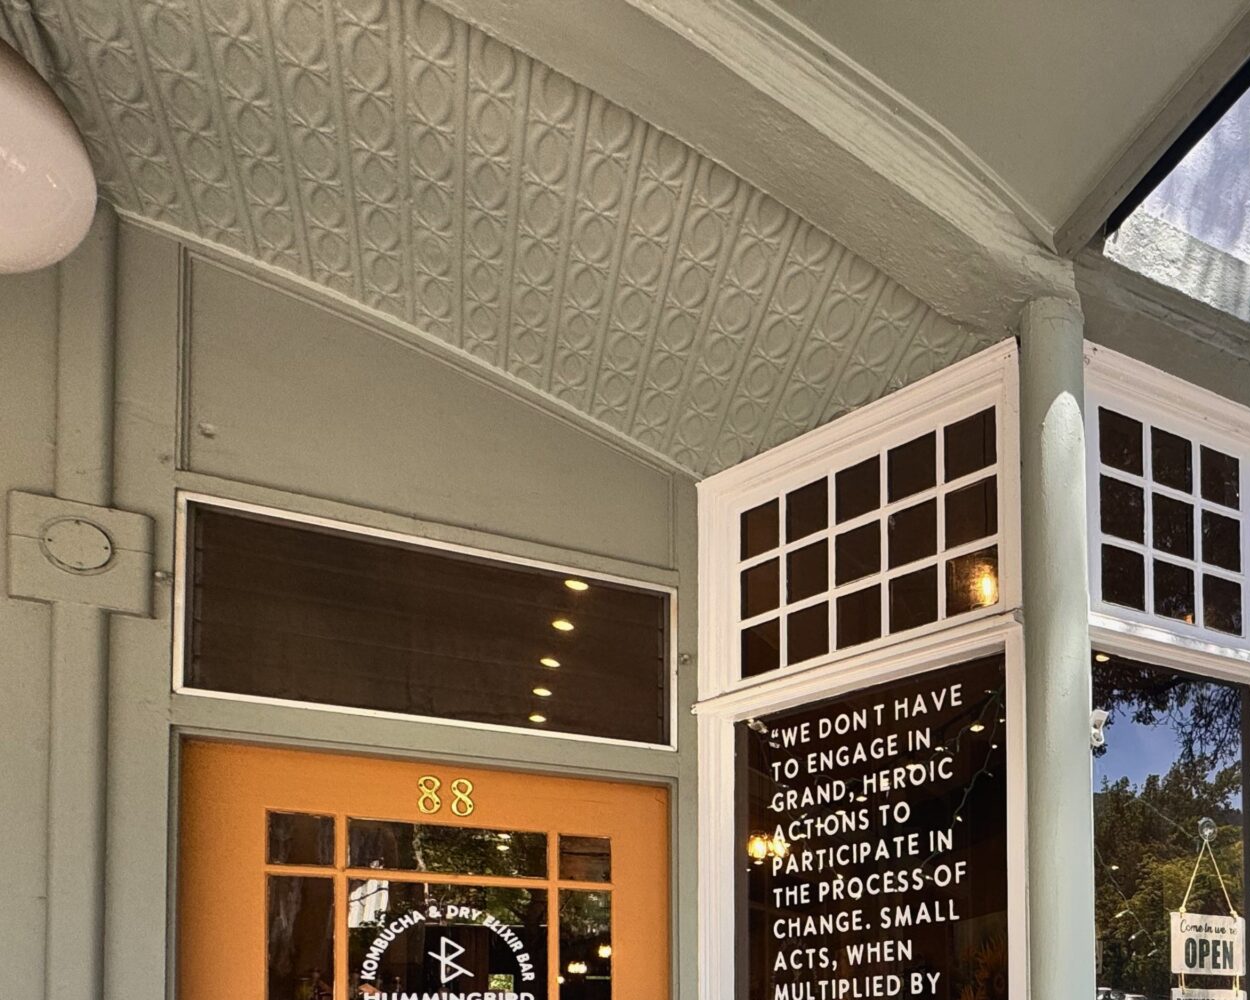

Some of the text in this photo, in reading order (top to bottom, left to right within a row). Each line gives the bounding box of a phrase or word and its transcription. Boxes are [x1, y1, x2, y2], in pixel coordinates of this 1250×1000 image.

[894, 684, 963, 720] HAVE
[771, 728, 931, 782] TO ENGAGE IN
[417, 774, 474, 816] 88
[771, 757, 953, 812] GRAND, HEROIC
[772, 801, 910, 843] ACTIONS TO
[772, 828, 953, 877] PARTICIPATE IN
[773, 861, 967, 909] THE PROCESS OF
[773, 899, 960, 939] CHANGE. SMALL
[360, 905, 536, 982] KOMBUCHA & DRY ELIXIR BAR
[773, 939, 913, 971] ACTS, WHEN
[1184, 937, 1234, 969] OPEN
[910, 972, 941, 995] BY
